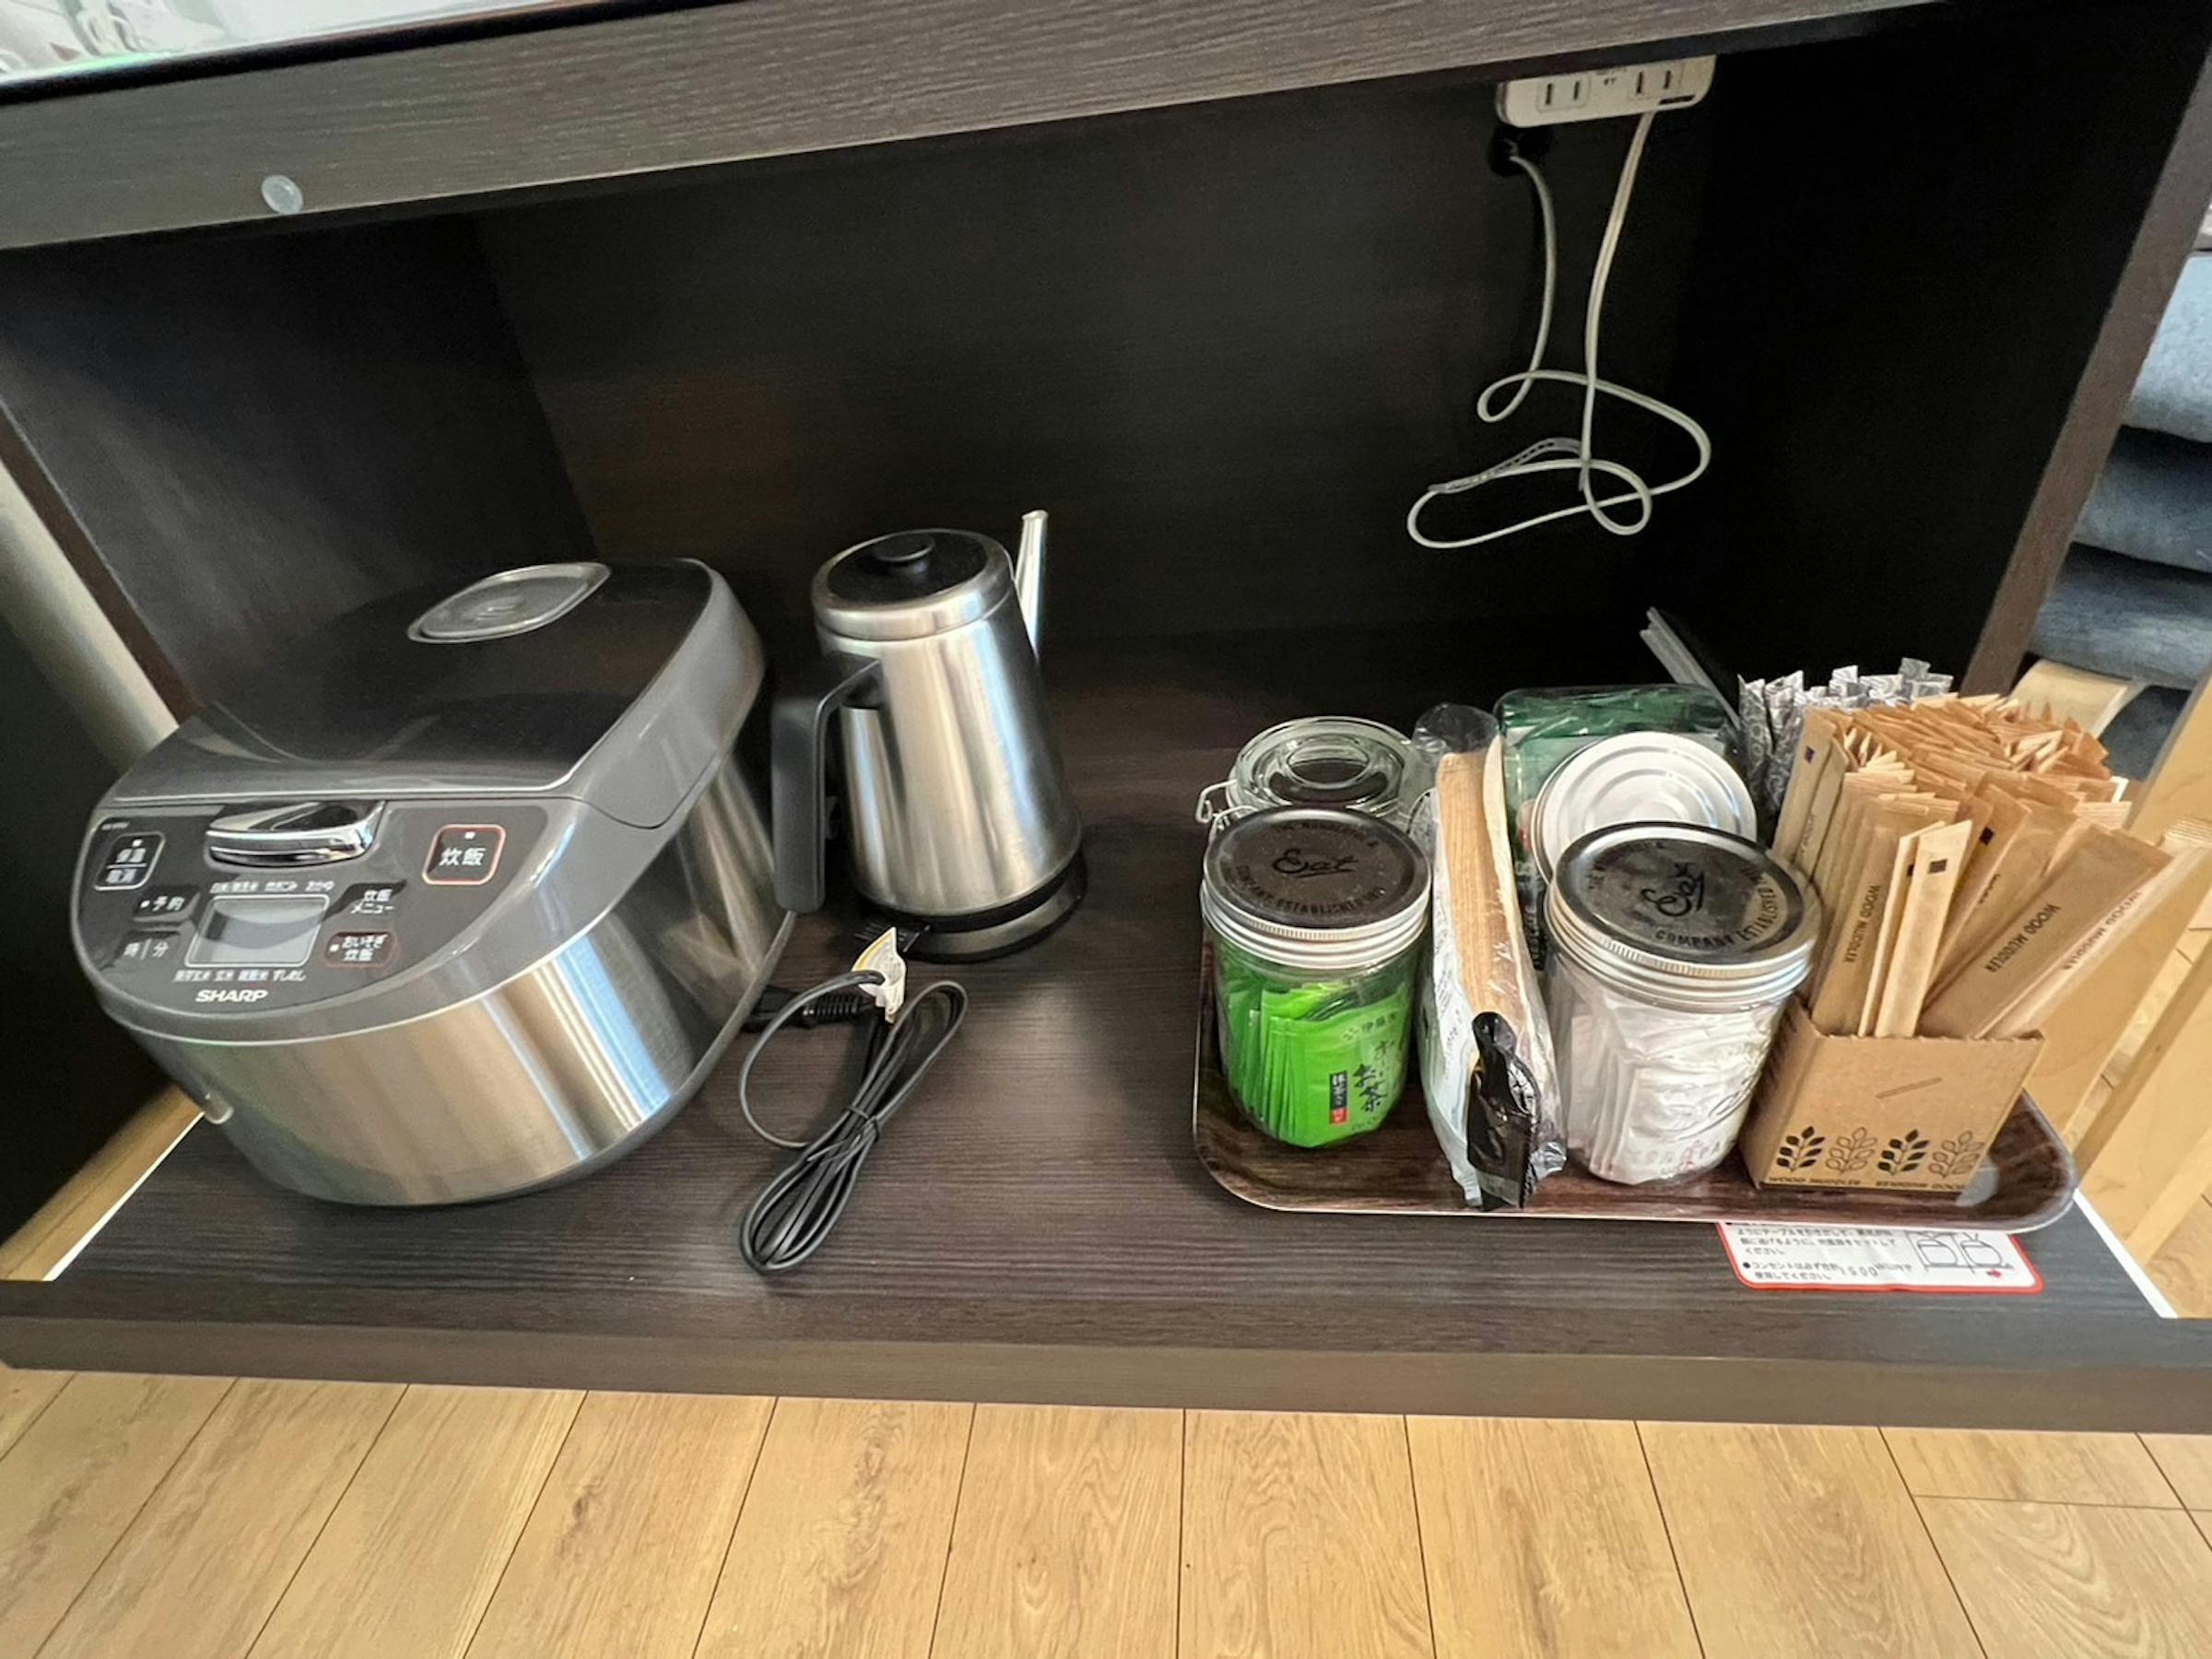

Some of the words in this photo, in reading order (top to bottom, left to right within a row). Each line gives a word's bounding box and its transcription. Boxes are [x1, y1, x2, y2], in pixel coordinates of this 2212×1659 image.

[440, 847, 487, 865] 炊飯
[153, 896, 185, 912] 予約
[350, 902, 395, 913] メニュー
[1859, 885, 1881, 918] WOOD
[2024, 902, 2062, 935] WOOD
[342, 934, 388, 948] おいそぎ
[1655, 930, 1735, 947] COMPANY
[195, 989, 268, 1003] SHARP
